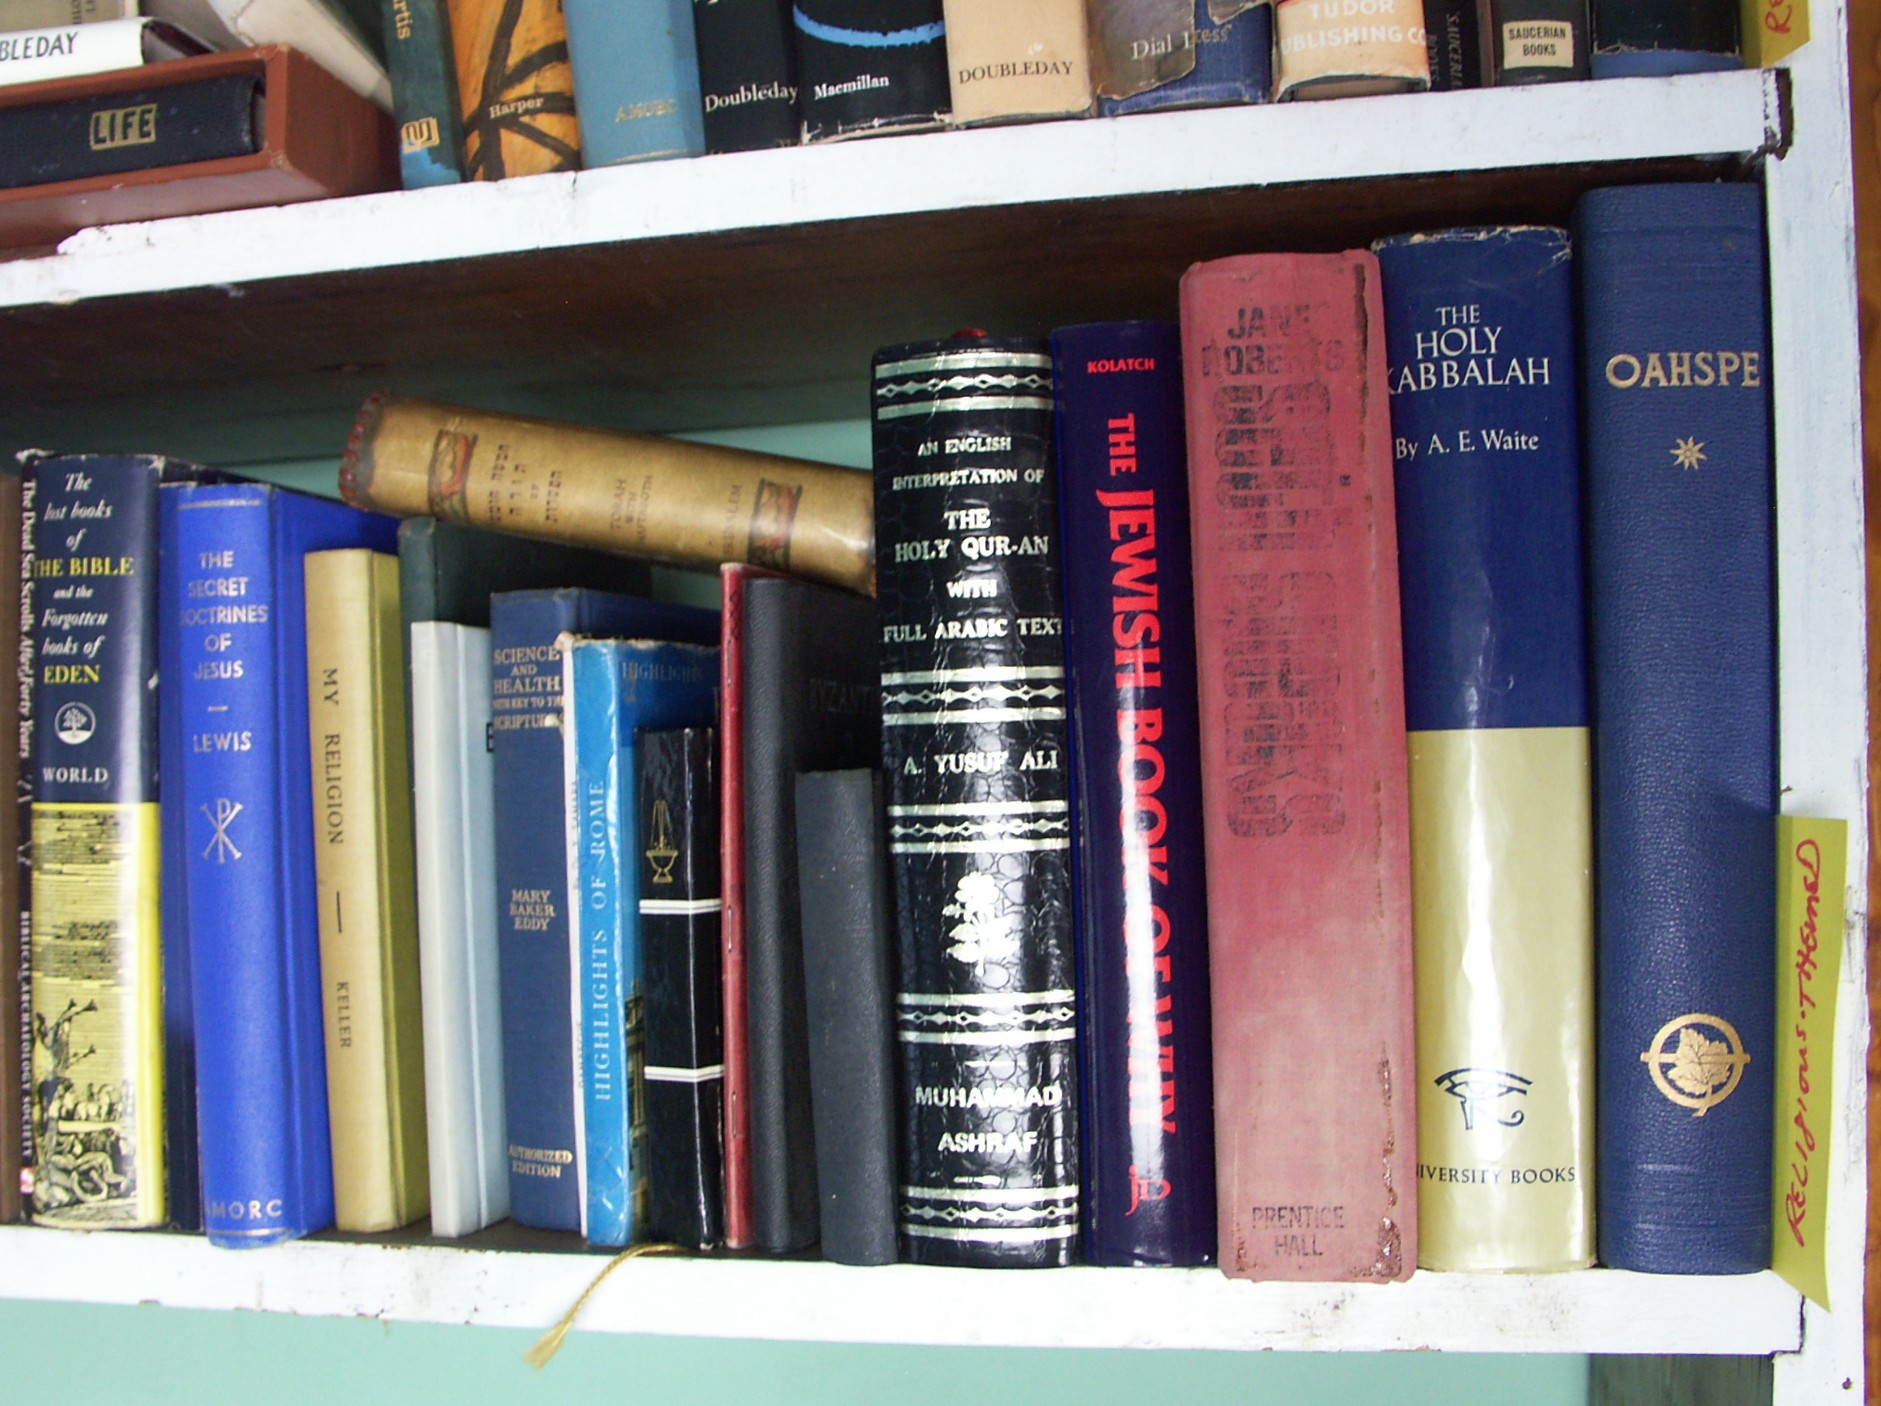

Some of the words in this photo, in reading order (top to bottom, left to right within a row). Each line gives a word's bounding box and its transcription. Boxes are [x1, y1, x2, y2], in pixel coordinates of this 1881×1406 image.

[1308, 0, 1396, 20] TUDOR
[1508, 26, 1567, 41] SAUCERIAN
[1130, 32, 1173, 60] Dial
[1522, 43, 1557, 57] BOOKS
[957, 60, 1075, 85] DOUBLEDAY
[704, 80, 799, 113] Doubleday
[813, 73, 890, 100] Macmillan
[489, 97, 545, 119] Harper
[92, 107, 154, 146] LIFE
[1227, 303, 1312, 340] JAE
[1435, 303, 1480, 327] THE
[1415, 325, 1503, 361] HOLY
[1086, 357, 1156, 374] KOLATCH
[1605, 351, 1762, 389] OAHSPE
[917, 440, 939, 457] AN
[945, 435, 1012, 455] ENGLISH
[1107, 412, 1138, 477] THE
[1395, 436, 1418, 461] By
[1427, 433, 1450, 456] A.
[1458, 430, 1475, 453] E.
[1480, 427, 1540, 452] Waite
[65, 471, 93, 493] The
[892, 467, 1018, 491] INTERPRETATION
[1023, 467, 1045, 484] OF
[43, 500, 68, 521] lost
[70, 498, 113, 519] books
[609, 478, 627, 530] TORAH
[21, 511, 37, 551] Dead
[943, 507, 992, 531] THE
[65, 527, 88, 553] of
[894, 539, 953, 563] HOLY
[960, 534, 1050, 562] QUR-AN
[21, 551, 36, 580] Sea
[33, 558, 64, 578] THE
[69, 556, 136, 577] BIBLE
[199, 549, 235, 570] THE
[53, 584, 74, 599] and
[75, 583, 95, 599] the
[187, 575, 249, 599] SECRET
[946, 578, 998, 599] WITH
[1095, 487, 1162, 690] JEWISH
[20, 580, 36, 634] Scrolls
[41, 607, 109, 631] Forgotten
[882, 624, 927, 644] FULL
[934, 617, 1009, 641] ARABIC
[1016, 615, 1064, 637] TEXT
[41, 635, 79, 656] books
[82, 634, 106, 660] of
[204, 632, 233, 653] OF
[492, 645, 561, 665] SCIENCE
[43, 664, 101, 685] EDEN
[193, 659, 244, 681] JESUS
[509, 663, 539, 677] AND
[322, 667, 340, 706] MY
[493, 675, 561, 695] HEALTH
[530, 696, 545, 709] TO
[492, 712, 565, 731] SCRIPTU
[18, 719, 34, 758] Years
[192, 730, 253, 754] LEWIS
[903, 755, 923, 776] A.
[933, 751, 1009, 775] YUSUF
[1018, 748, 1059, 771] ALI
[42, 766, 110, 784] WORLD
[324, 732, 344, 845] RELIGION
[1116, 706, 1169, 888] BOOK
[588, 780, 606, 866] ROME
[511, 888, 551, 905] MARY
[590, 875, 607, 911] OF
[508, 903, 556, 918] BAKER
[512, 916, 550, 931] EDDY
[1122, 903, 1173, 984] OF
[336, 980, 352, 1048] KELLER
[590, 928, 611, 1101] HIGHLIGHTS
[914, 1084, 1064, 1109] MUHAMMAD
[20, 1095, 33, 1158] SOCIETY
[508, 1143, 574, 1165] AUTHORIZED
[937, 1130, 1040, 1154] ASHRAF
[511, 1159, 562, 1179] EDITION
[1510, 1165, 1576, 1185] BOOKS
[1251, 1205, 1346, 1230] PRENTICE
[1274, 1234, 1324, 1258] HALL
